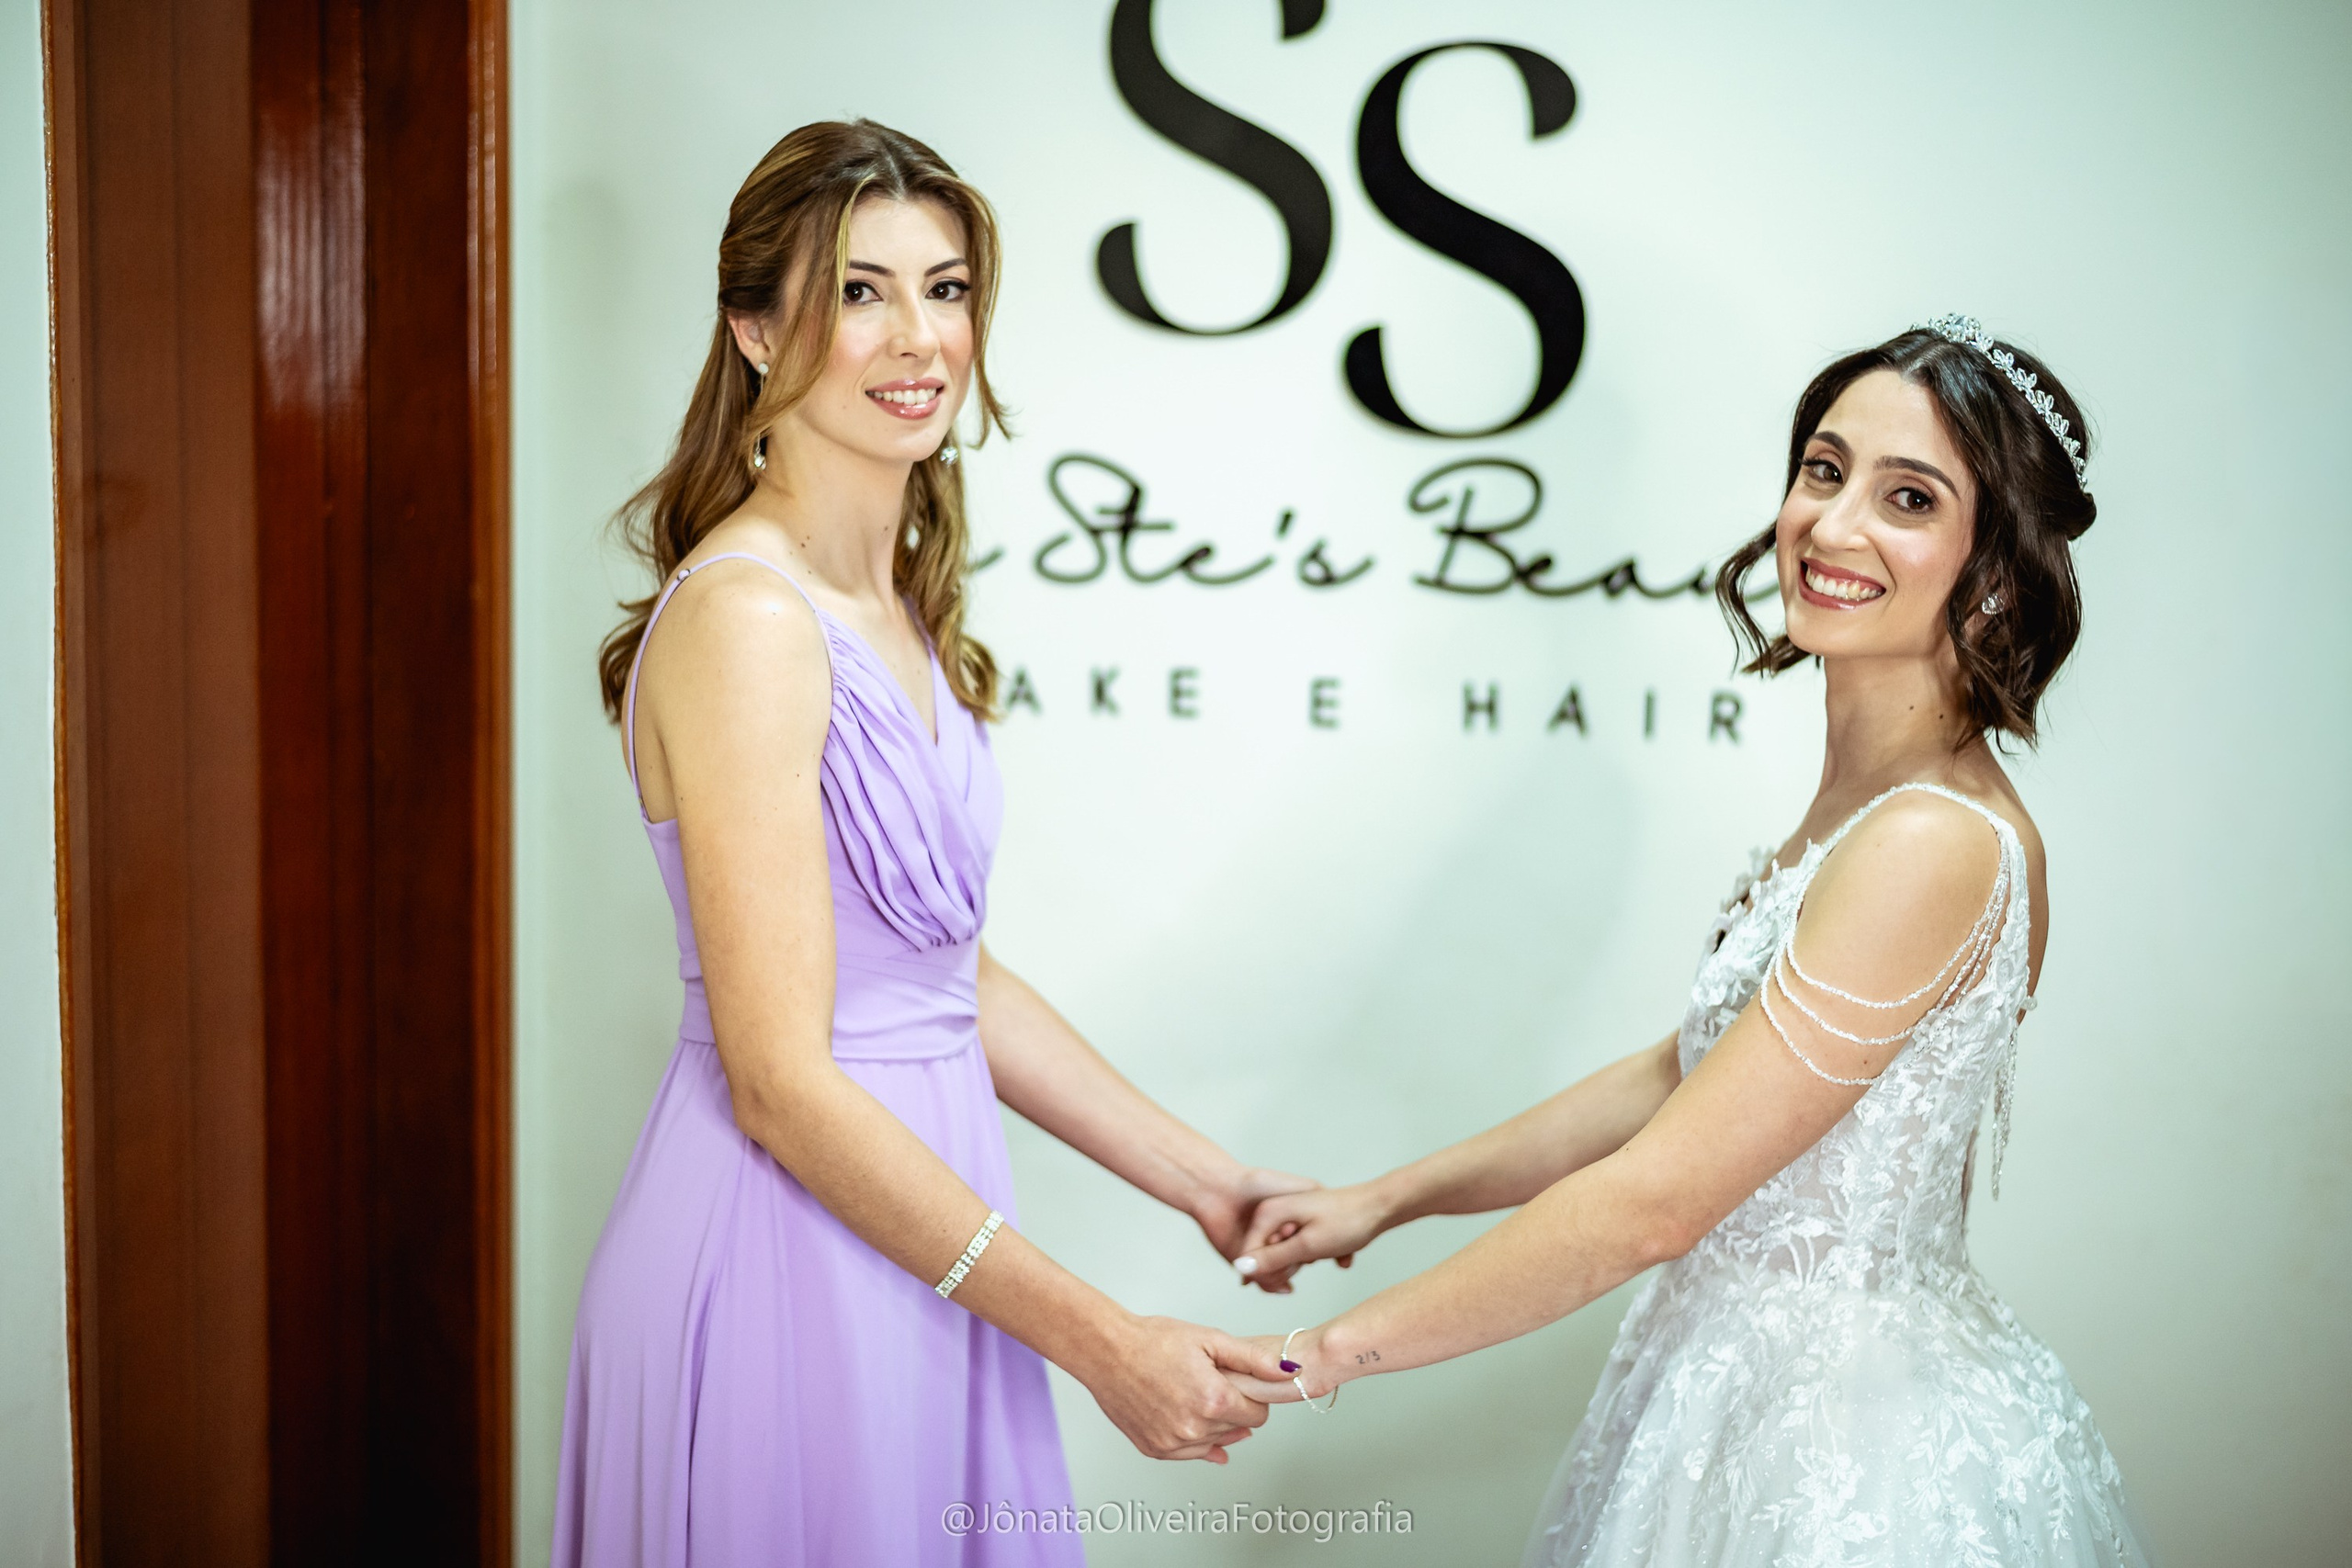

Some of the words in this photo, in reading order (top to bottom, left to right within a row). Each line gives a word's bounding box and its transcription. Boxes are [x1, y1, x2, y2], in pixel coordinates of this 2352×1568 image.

[1033, 452, 1374, 589] Ste's
[1006, 667, 1199, 719] AKE
[1307, 676, 1340, 730] E
[1462, 683, 1744, 744] HAIR
